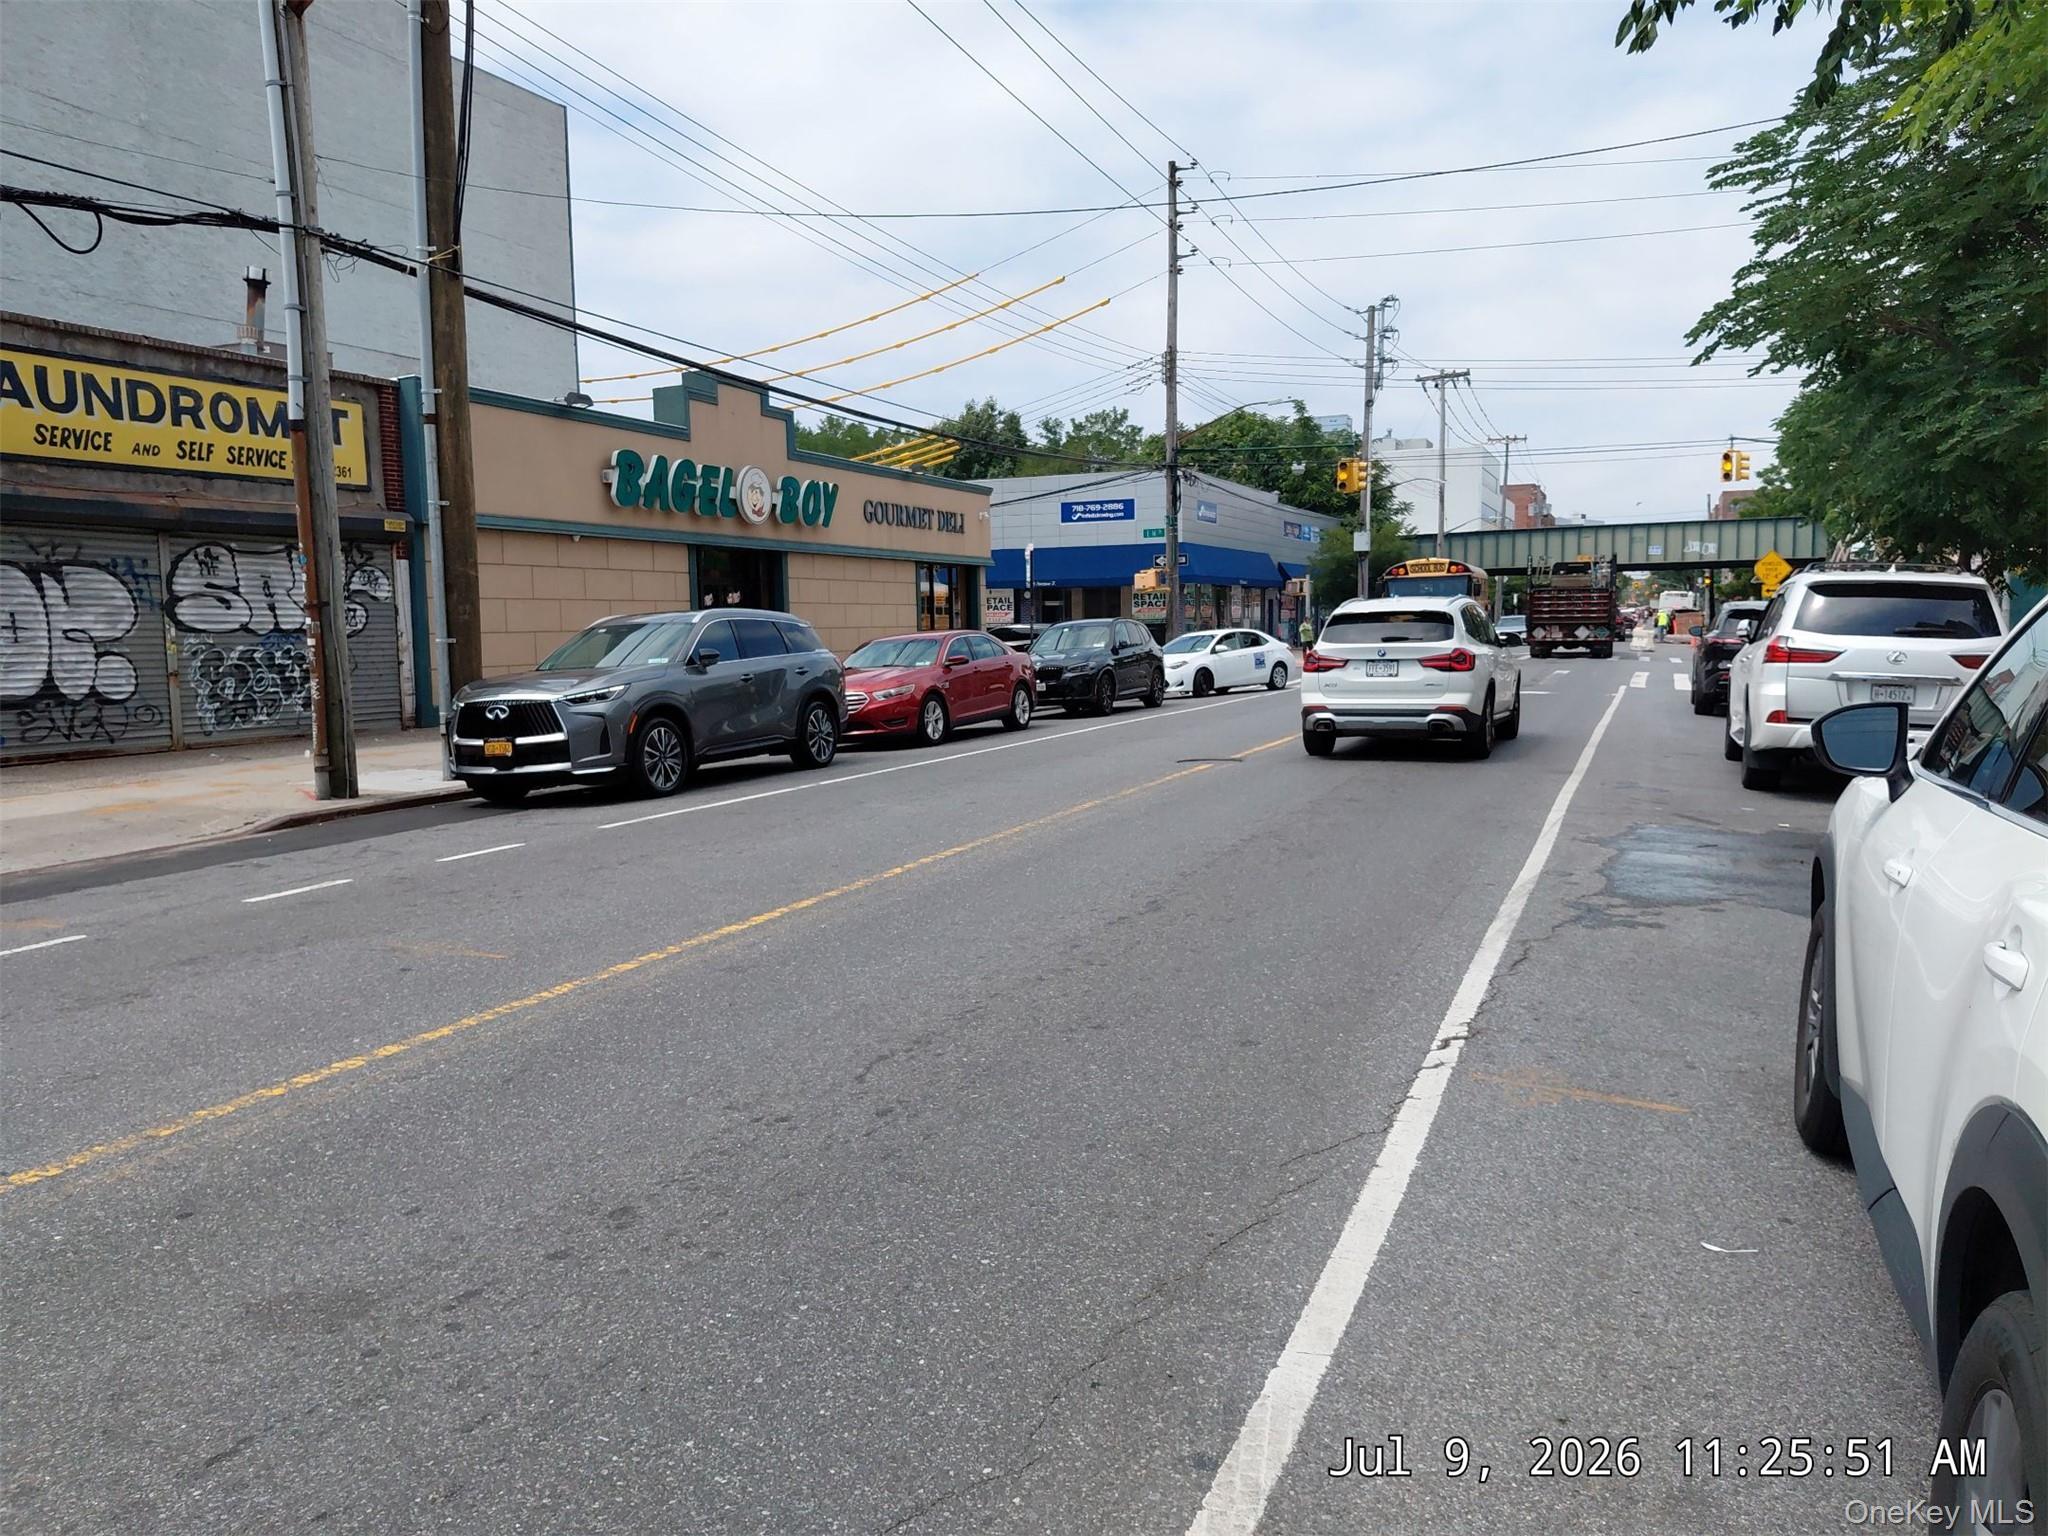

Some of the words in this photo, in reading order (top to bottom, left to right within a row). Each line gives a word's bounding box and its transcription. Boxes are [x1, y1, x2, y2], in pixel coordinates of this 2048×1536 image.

[0, 360, 349, 446] AUNDROMT
[33, 423, 113, 453] SERVICE
[131, 442, 161, 457] AND
[176, 439, 215, 463] SELF
[226, 445, 288, 471] SERVICE
[335, 465, 352, 479] 361
[611, 448, 738, 519] BAGEL
[776, 475, 840, 529] BOY
[863, 499, 935, 531] GOURMET
[936, 510, 966, 534] DELI
[1071, 502, 1125, 513] 718-769-2886
